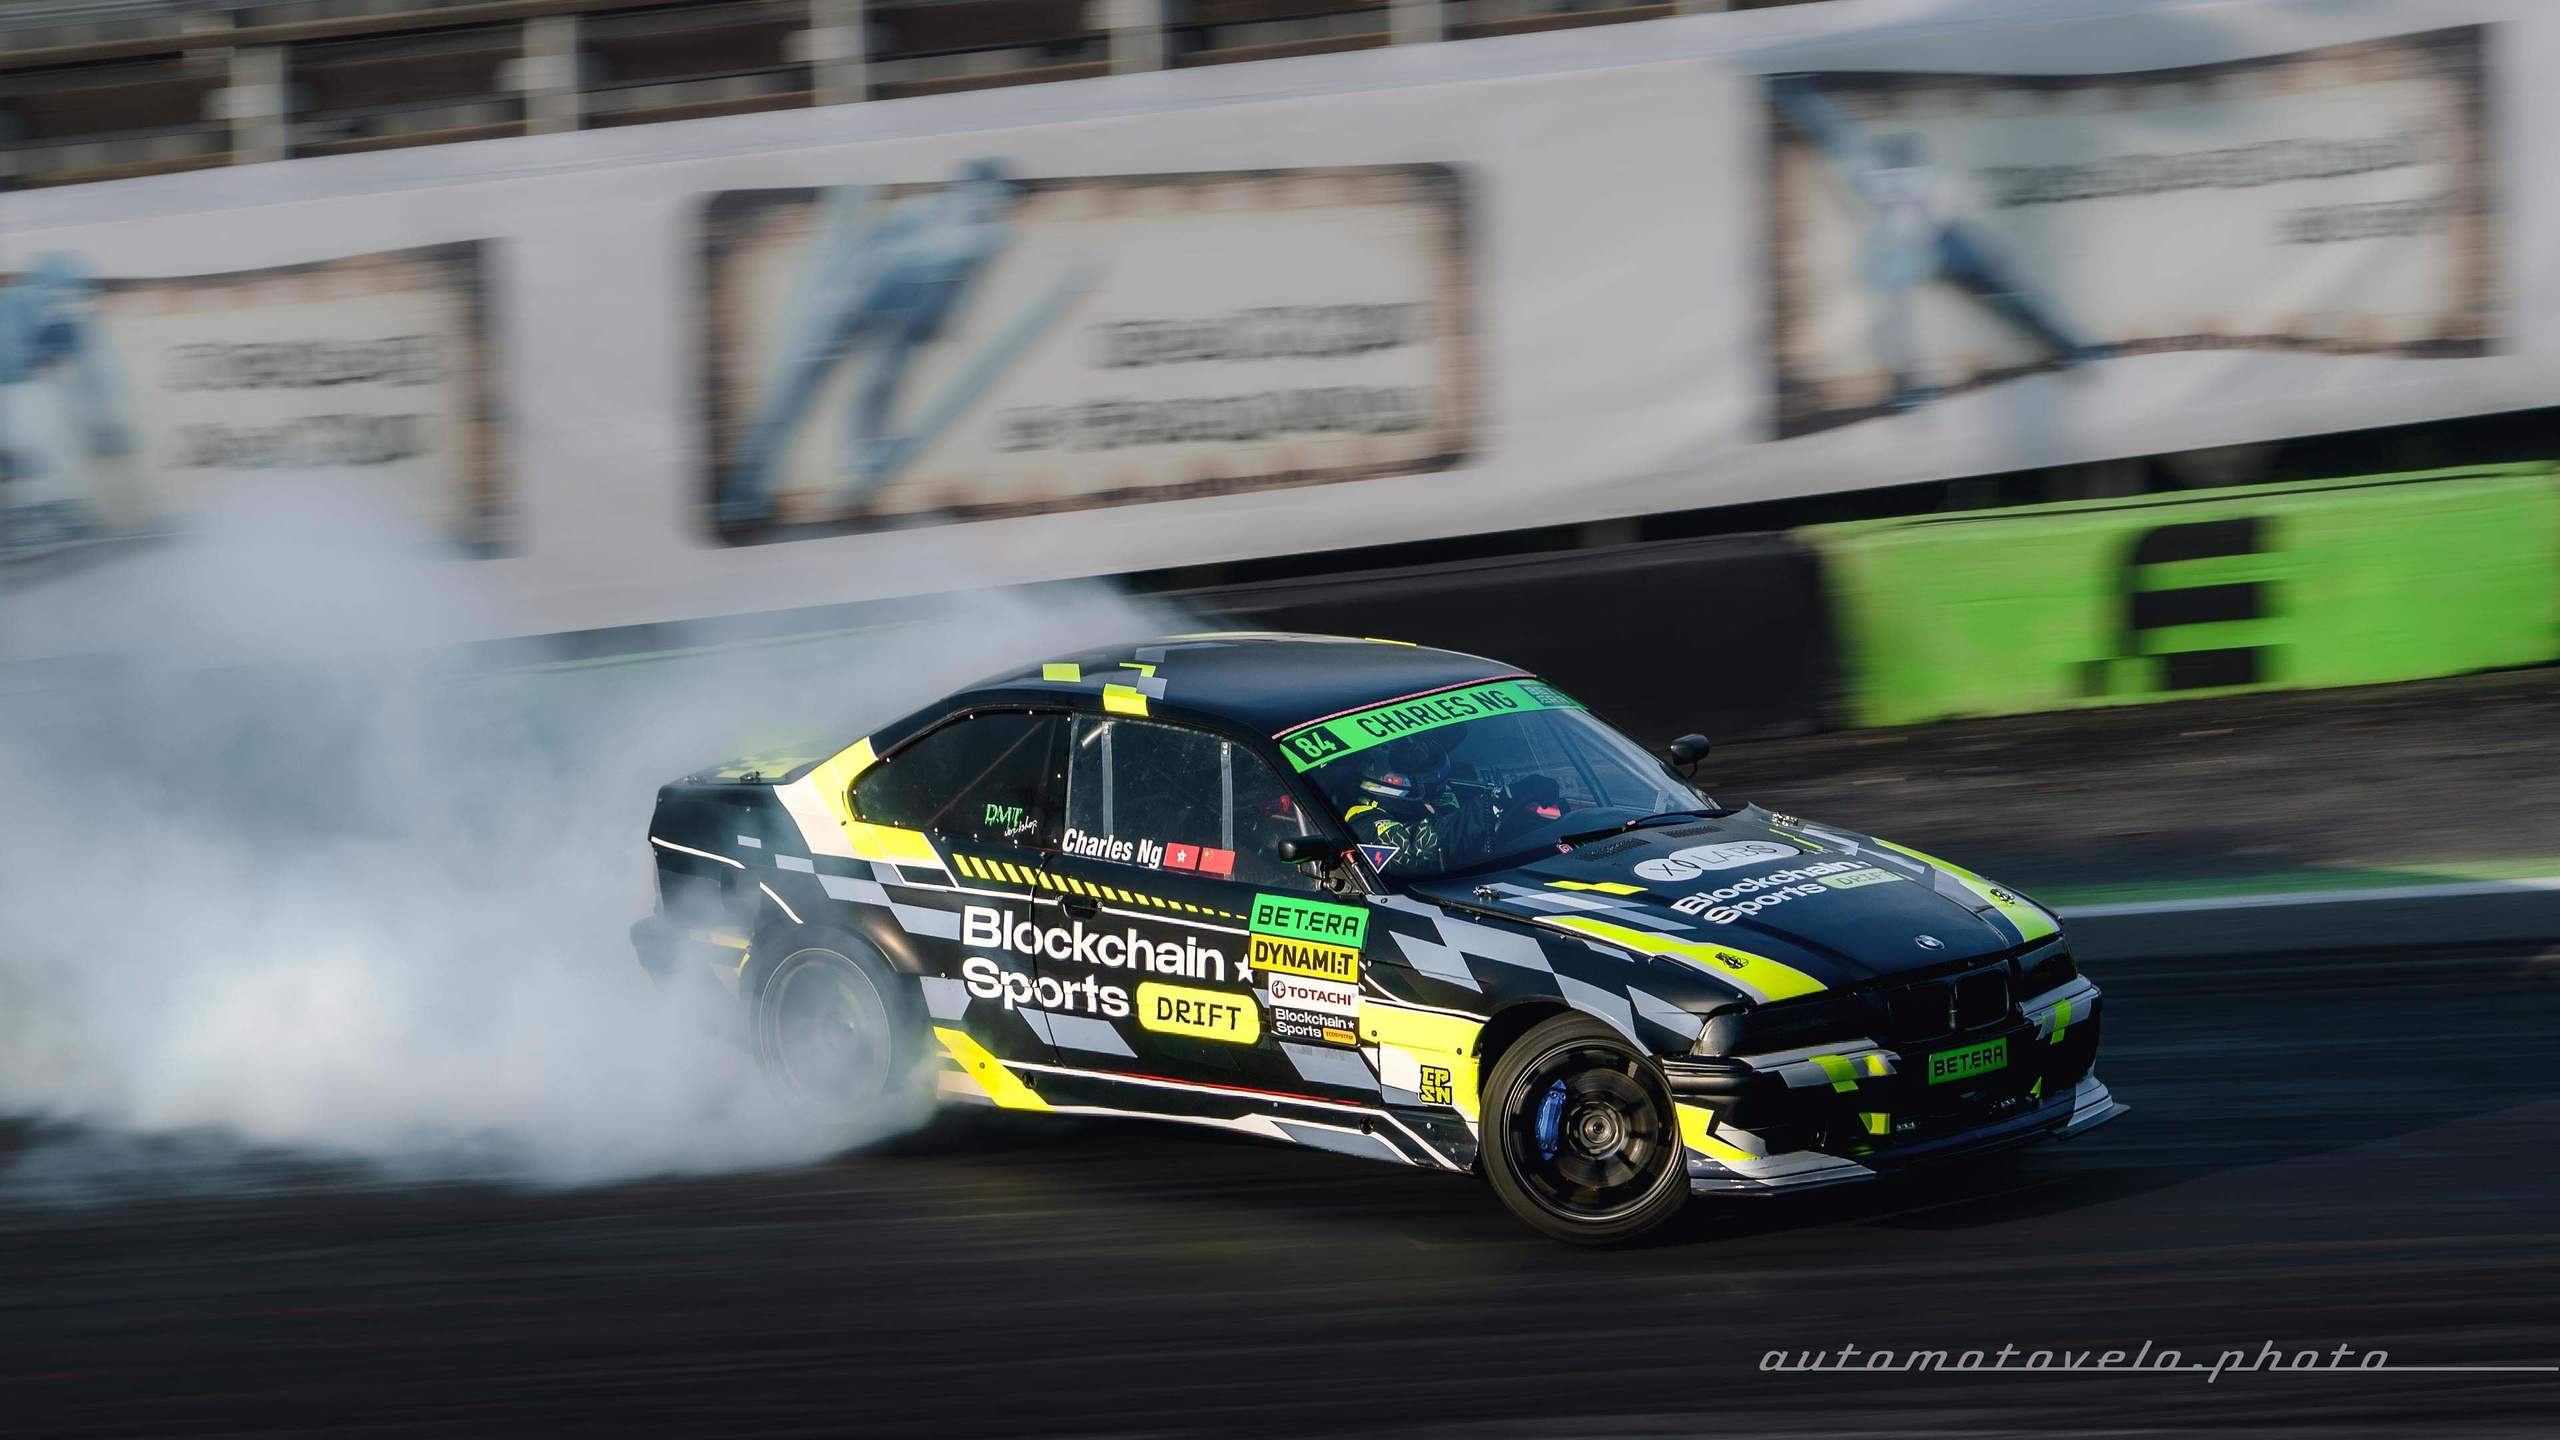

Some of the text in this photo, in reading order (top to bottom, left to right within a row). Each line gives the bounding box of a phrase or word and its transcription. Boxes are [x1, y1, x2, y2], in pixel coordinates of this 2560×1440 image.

[1294, 690, 1518, 758] 84 CHARLES NG
[985, 803, 1023, 829] DMT
[1062, 828, 1163, 869] Charles Ng
[1691, 844, 1778, 864] LABS
[1671, 861, 1864, 916] Blockchain
[1703, 883, 1828, 925] Sports
[962, 904, 1226, 982] Blockchain
[962, 956, 1242, 1031] Sports DRIFT
[1275, 1008, 1347, 1029] Blockchain
[1276, 1021, 1354, 1041] Sports ECOSYSTEM
